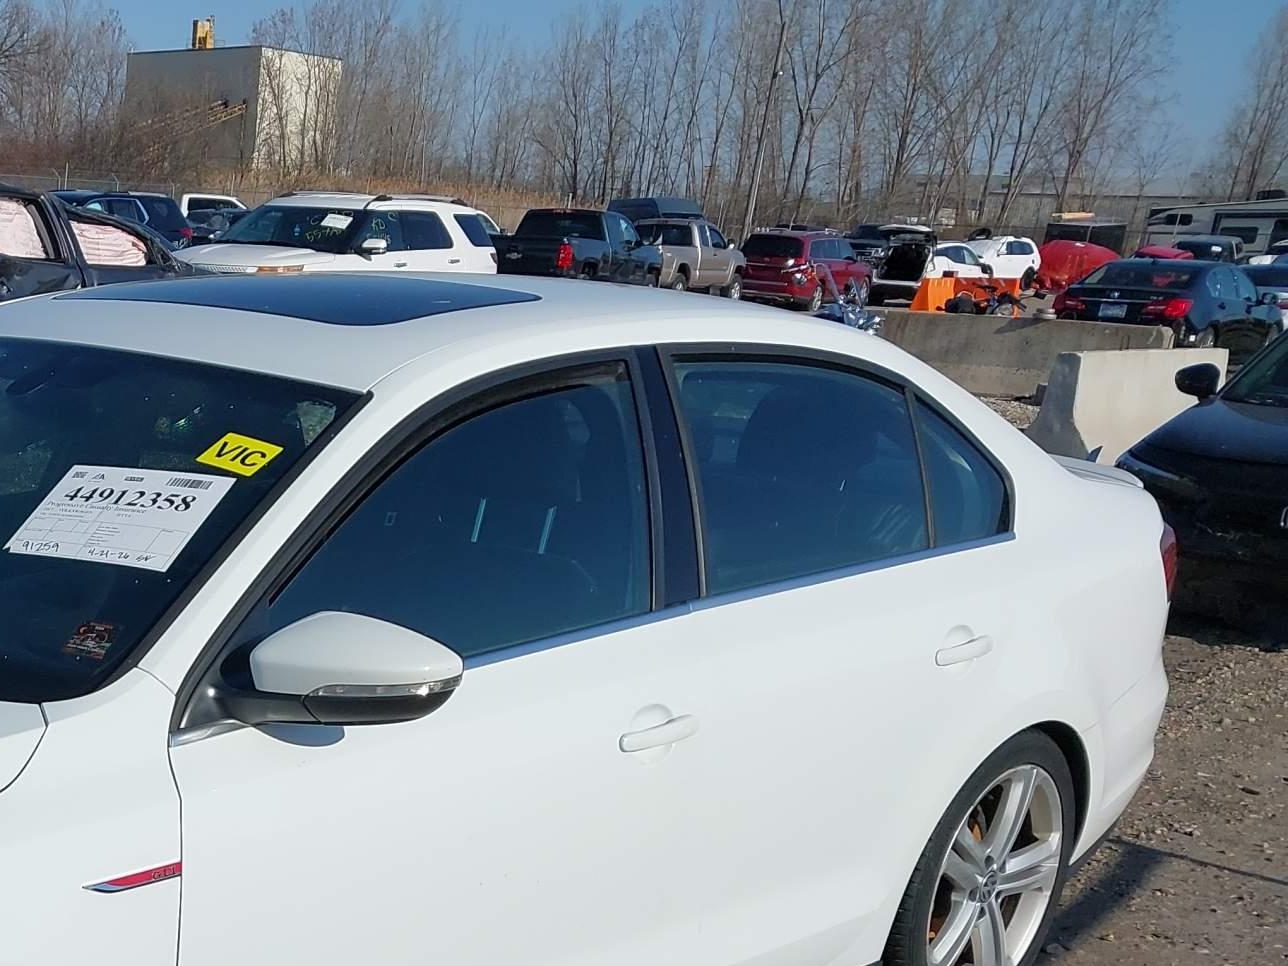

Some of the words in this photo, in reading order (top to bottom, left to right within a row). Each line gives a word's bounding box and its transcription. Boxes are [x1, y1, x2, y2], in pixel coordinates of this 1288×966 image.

[215, 441, 267, 467] VIC
[64, 486, 197, 512] 44912358
[22, 540, 59, 553] 91259
